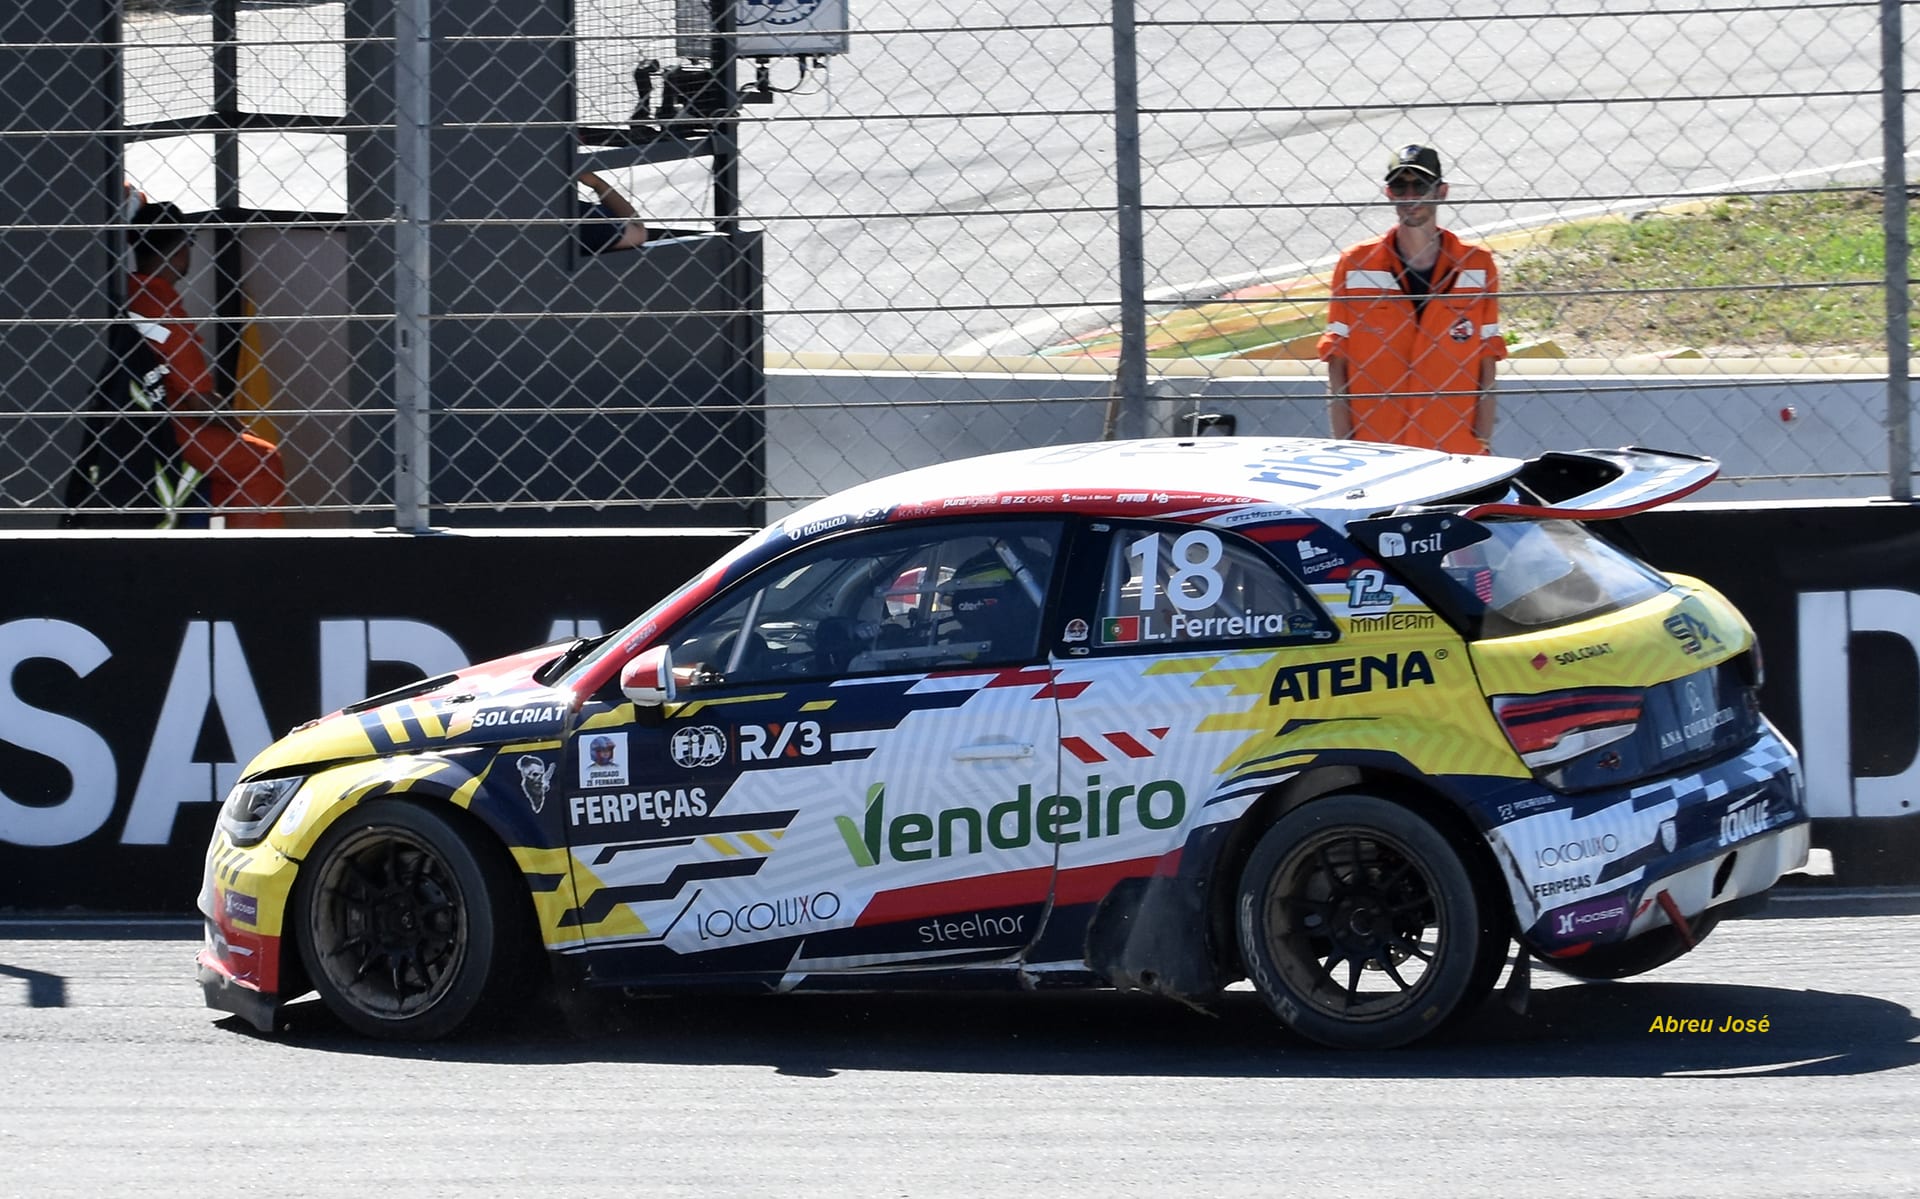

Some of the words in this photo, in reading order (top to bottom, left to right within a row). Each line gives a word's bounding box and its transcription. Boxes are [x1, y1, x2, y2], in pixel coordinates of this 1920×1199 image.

[1027, 495, 1054, 504] CARS
[804, 515, 848, 537] tábuas
[1411, 533, 1443, 554] rsil
[1131, 530, 1223, 611] 18
[1303, 557, 1345, 575] lousada
[1144, 616, 1166, 640] L.
[1171, 610, 1283, 639] Ferreira
[472, 705, 567, 728] SOLCRIAT
[569, 788, 708, 827] FERPEÇAS
[834, 774, 1186, 867] Vendeiro
[1535, 833, 1620, 868] LOCOLUXO
[1533, 874, 1591, 898] FERPEÇAS
[697, 891, 840, 940] LOCOLUXO
[918, 913, 1025, 943] steelnor
[1575, 906, 1625, 925] HOOSIER
